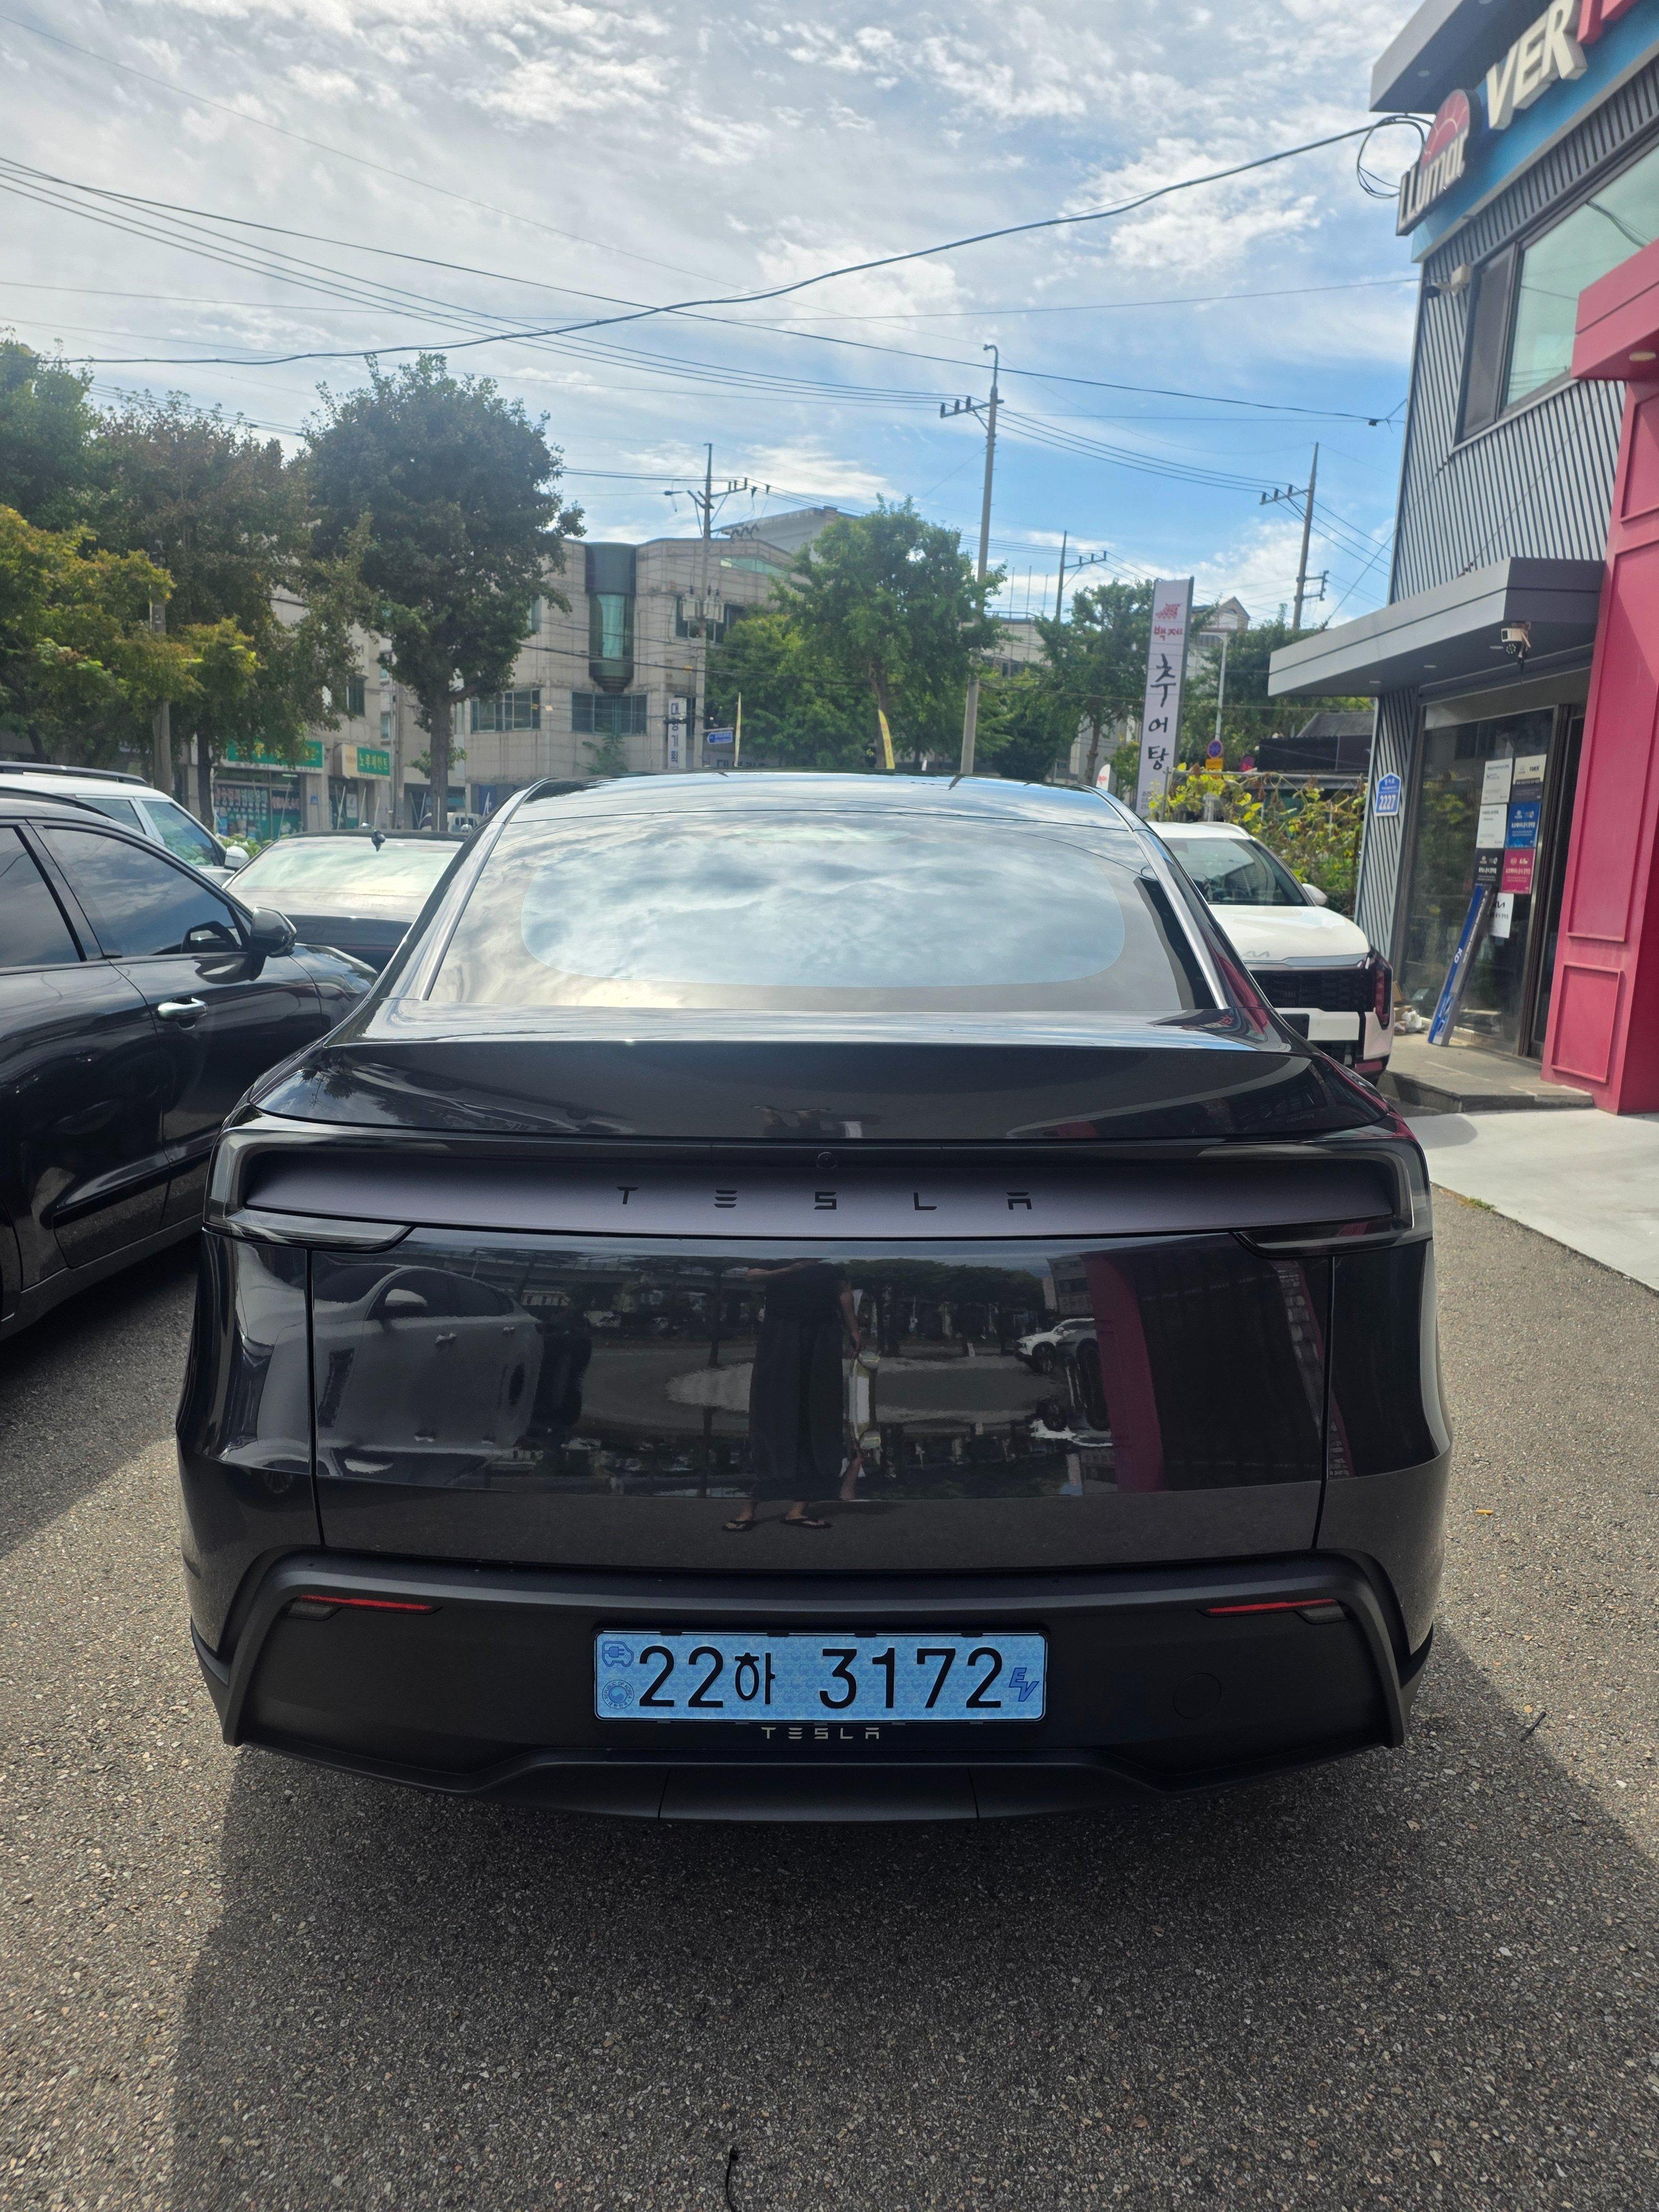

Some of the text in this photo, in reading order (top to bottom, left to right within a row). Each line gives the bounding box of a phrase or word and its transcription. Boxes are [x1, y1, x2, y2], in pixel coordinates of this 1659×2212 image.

[1485, 0, 1626, 130] VER
[1147, 653, 1177, 770] 추어탕
[1379, 795, 1396, 811] 2227
[617, 1186, 1032, 1211] TESLA
[603, 1681, 617, 1699] REPUBLIC
[624, 1684, 633, 1699] KOREA
[638, 1645, 1003, 1709] 22하 3172
[1009, 1667, 1040, 1702] EV
[761, 1726, 880, 1740] TESLA
